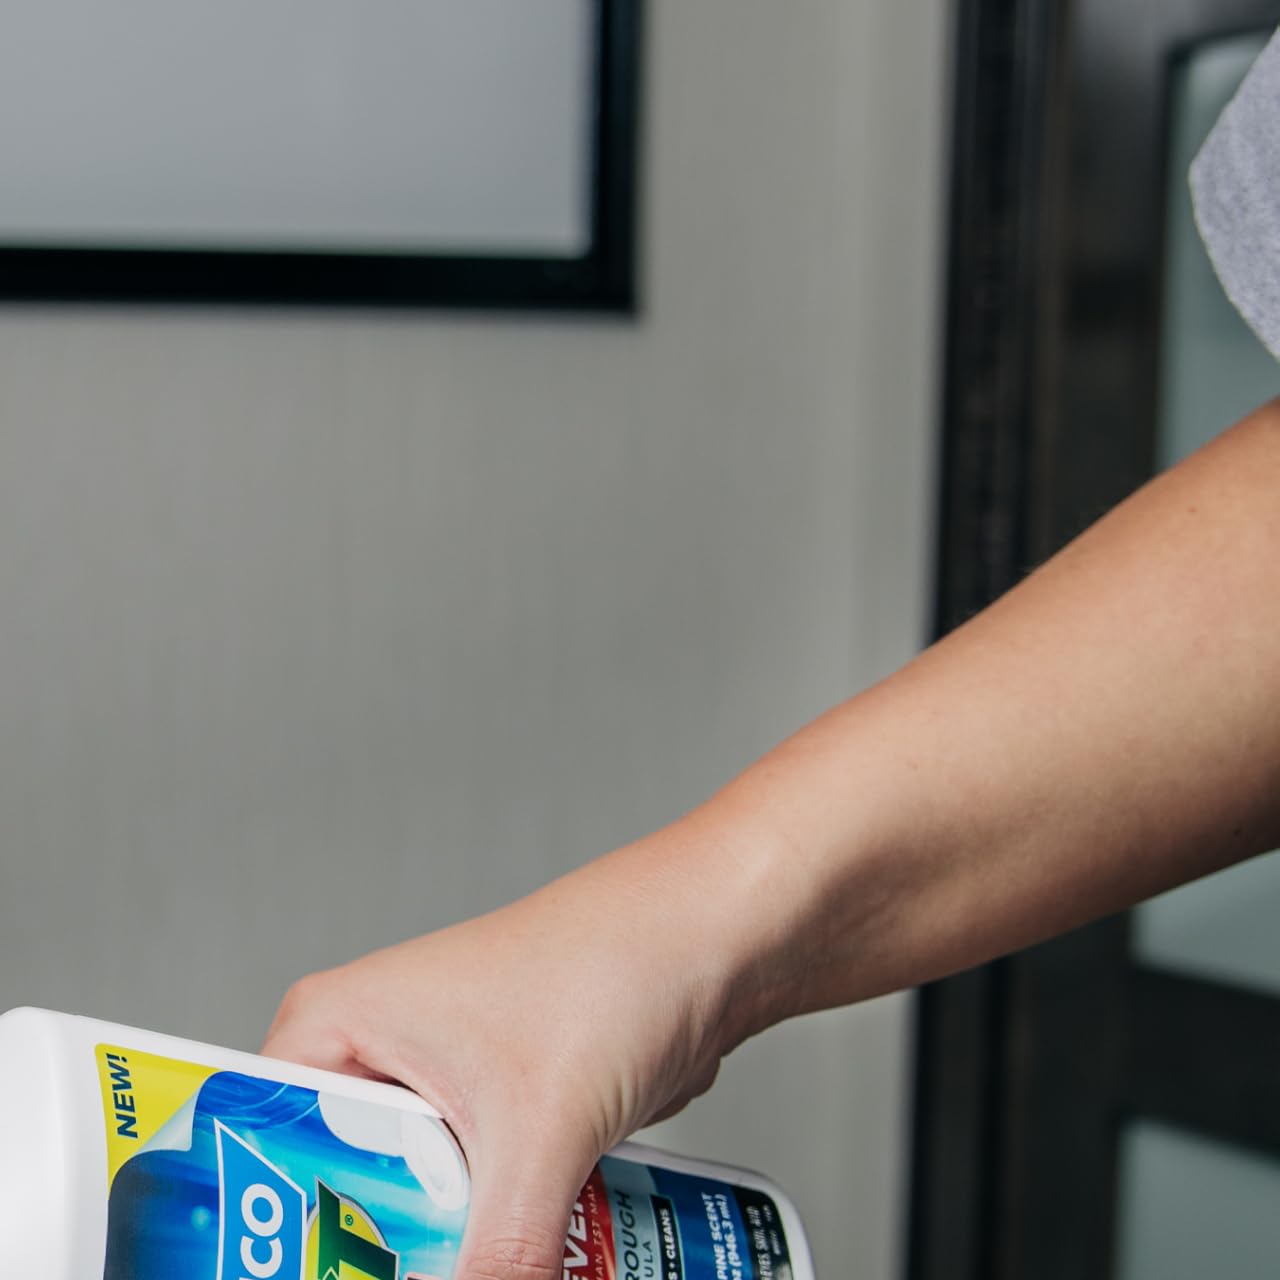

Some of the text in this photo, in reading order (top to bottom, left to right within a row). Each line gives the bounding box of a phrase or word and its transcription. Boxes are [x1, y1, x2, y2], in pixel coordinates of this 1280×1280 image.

[105, 1052, 138, 1139] NEW!
[591, 1220, 602, 1247] TST
[660, 1208, 676, 1260] CLEANS
[701, 1192, 722, 1242] SCENT
[713, 1243, 728, 1280] PINE
